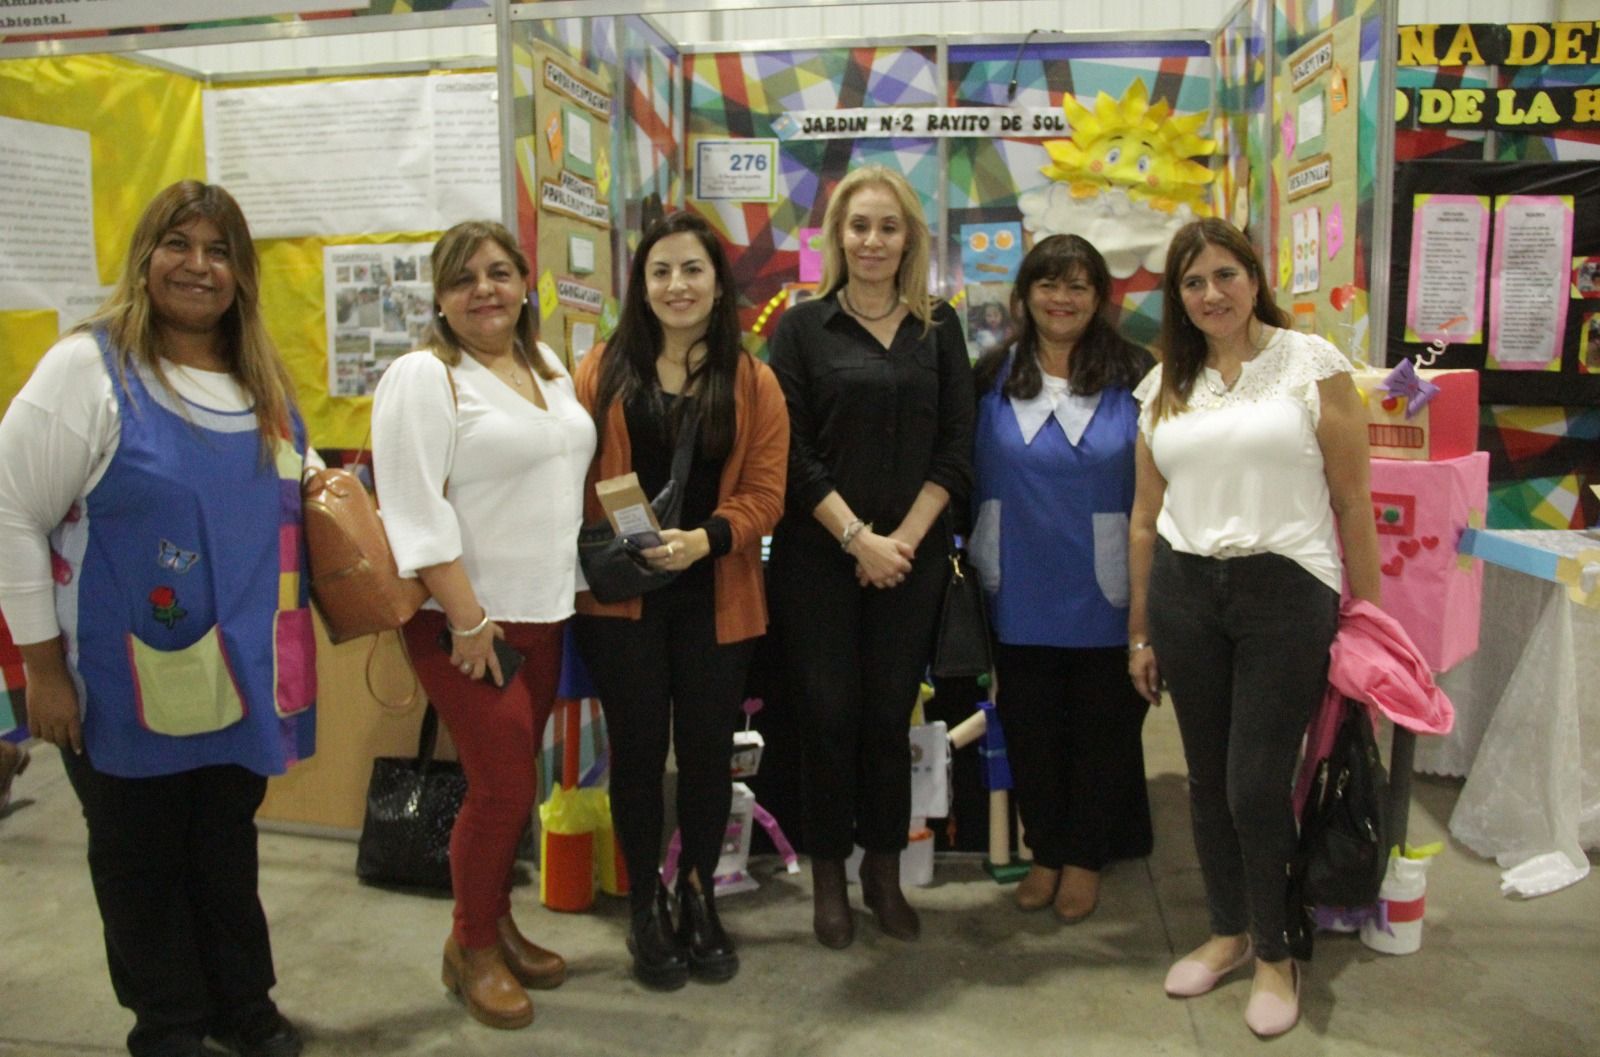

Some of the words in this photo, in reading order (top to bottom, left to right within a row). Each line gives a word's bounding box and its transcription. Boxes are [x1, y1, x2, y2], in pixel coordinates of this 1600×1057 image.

[1504, 22, 1600, 66] DE
[1419, 88, 1485, 124] DE
[1496, 88, 1562, 125] LA
[803, 115, 868, 134] JARDIN
[927, 114, 990, 132] RAYITO
[1001, 114, 1022, 131] DE
[1033, 114, 1064, 131] SOL
[730, 154, 767, 171] 276
